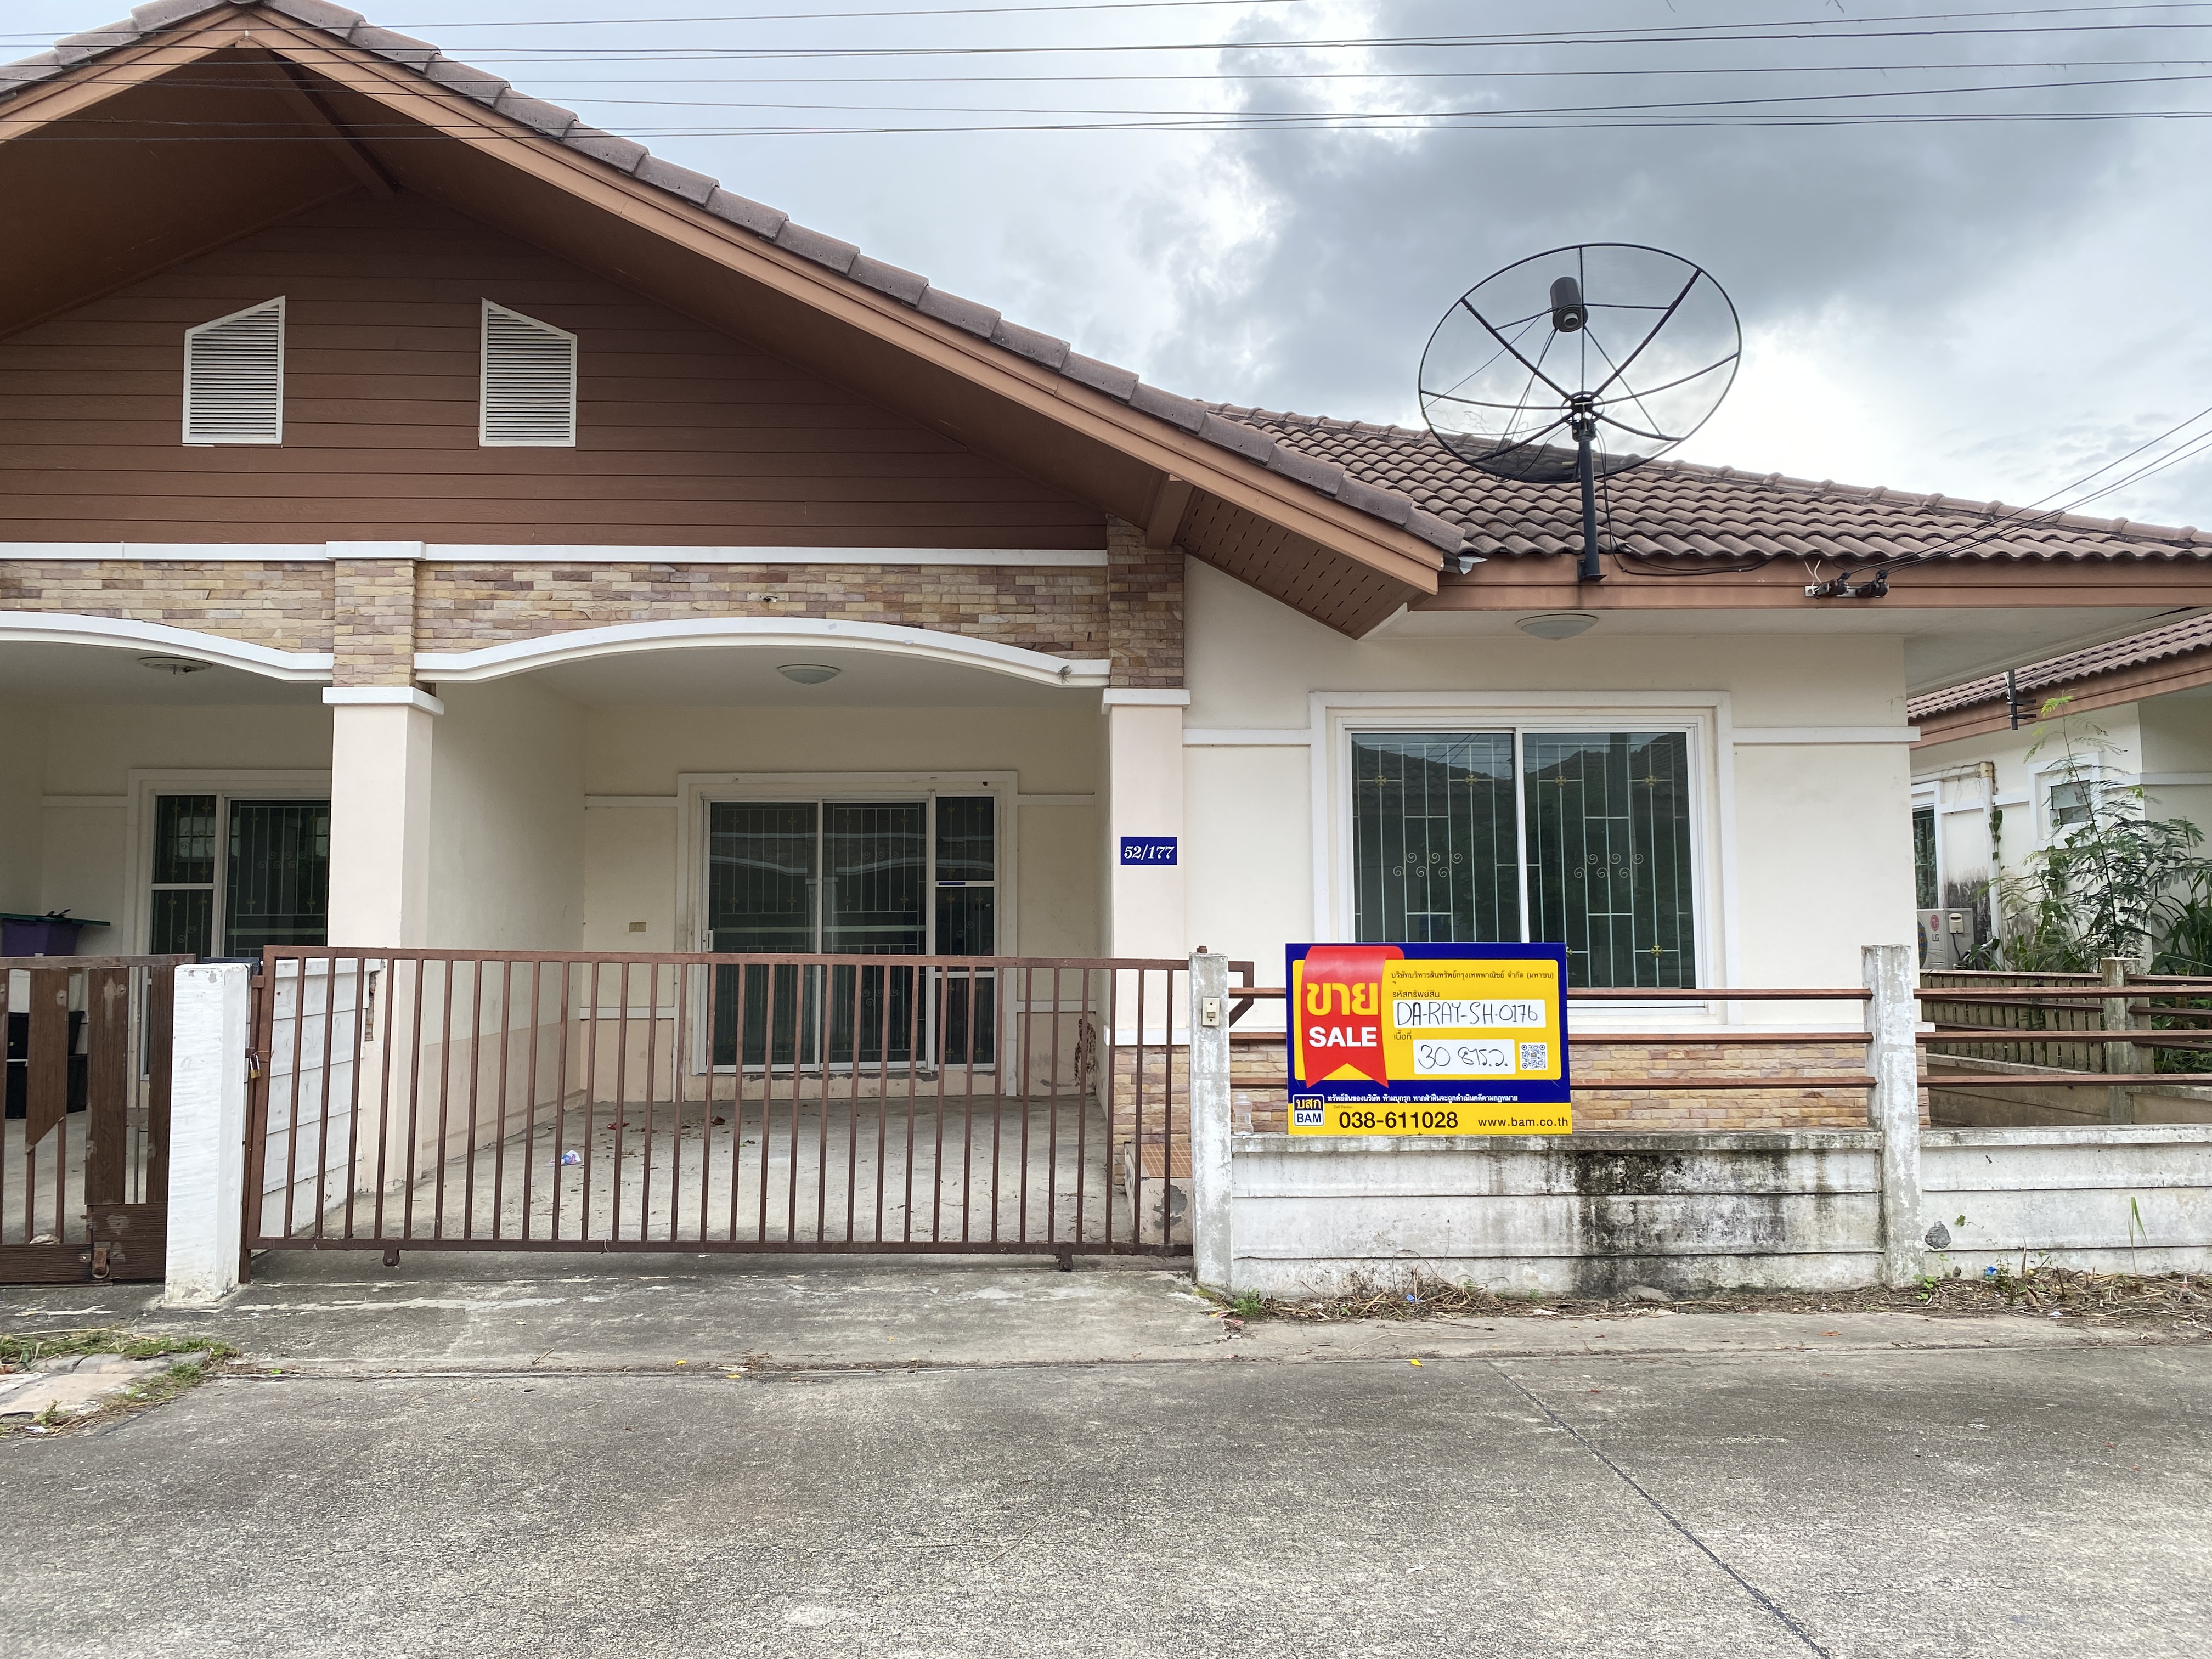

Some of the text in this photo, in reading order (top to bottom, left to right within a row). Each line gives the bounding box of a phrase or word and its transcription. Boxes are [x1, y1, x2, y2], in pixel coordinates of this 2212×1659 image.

[1124, 844, 1175, 860] 52/177
[1932, 934, 1939, 942] LG
[1307, 983, 1379, 1016] ขาย
[1392, 990, 1440, 998] รหัสทรัพย์สิน
[1308, 1026, 1378, 1047] SALE
[1393, 1030, 1412, 1040] เนื้อที่
[1418, 1045, 1451, 1069] 30
[1296, 1098, 1321, 1109] บสก
[1297, 1113, 1321, 1123] BAM
[1339, 1111, 1458, 1128] 038-611028
[1478, 1117, 1568, 1126] www.bam.co.th
